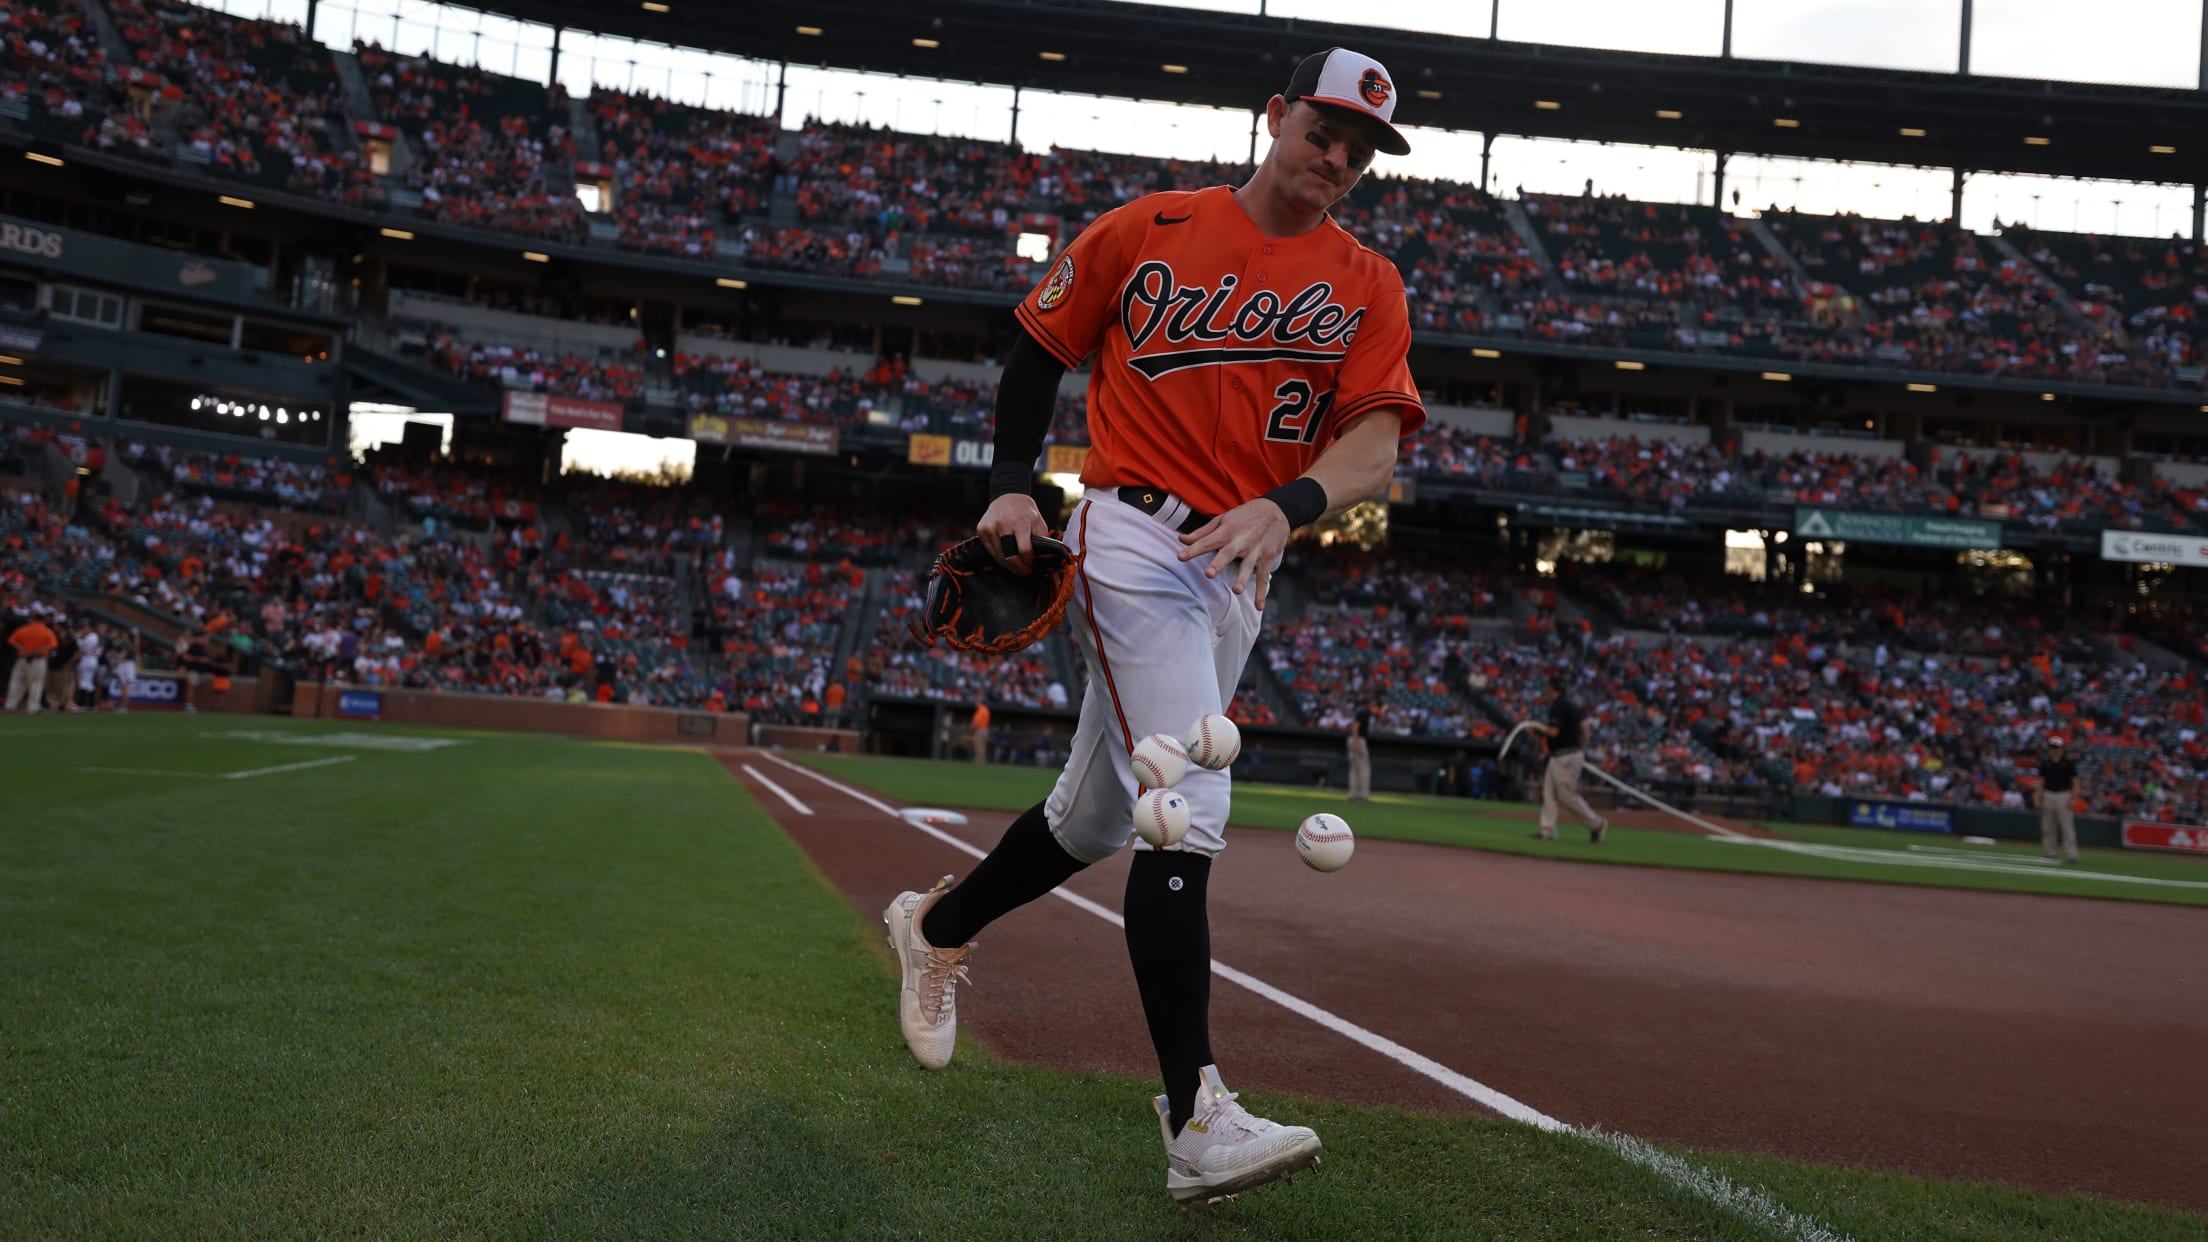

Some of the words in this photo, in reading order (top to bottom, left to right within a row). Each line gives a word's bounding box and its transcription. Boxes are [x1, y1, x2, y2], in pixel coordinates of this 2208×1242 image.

[0, 222, 62, 259] RDS
[1121, 260, 1368, 352] Orioles
[1264, 378, 1336, 446] 21
